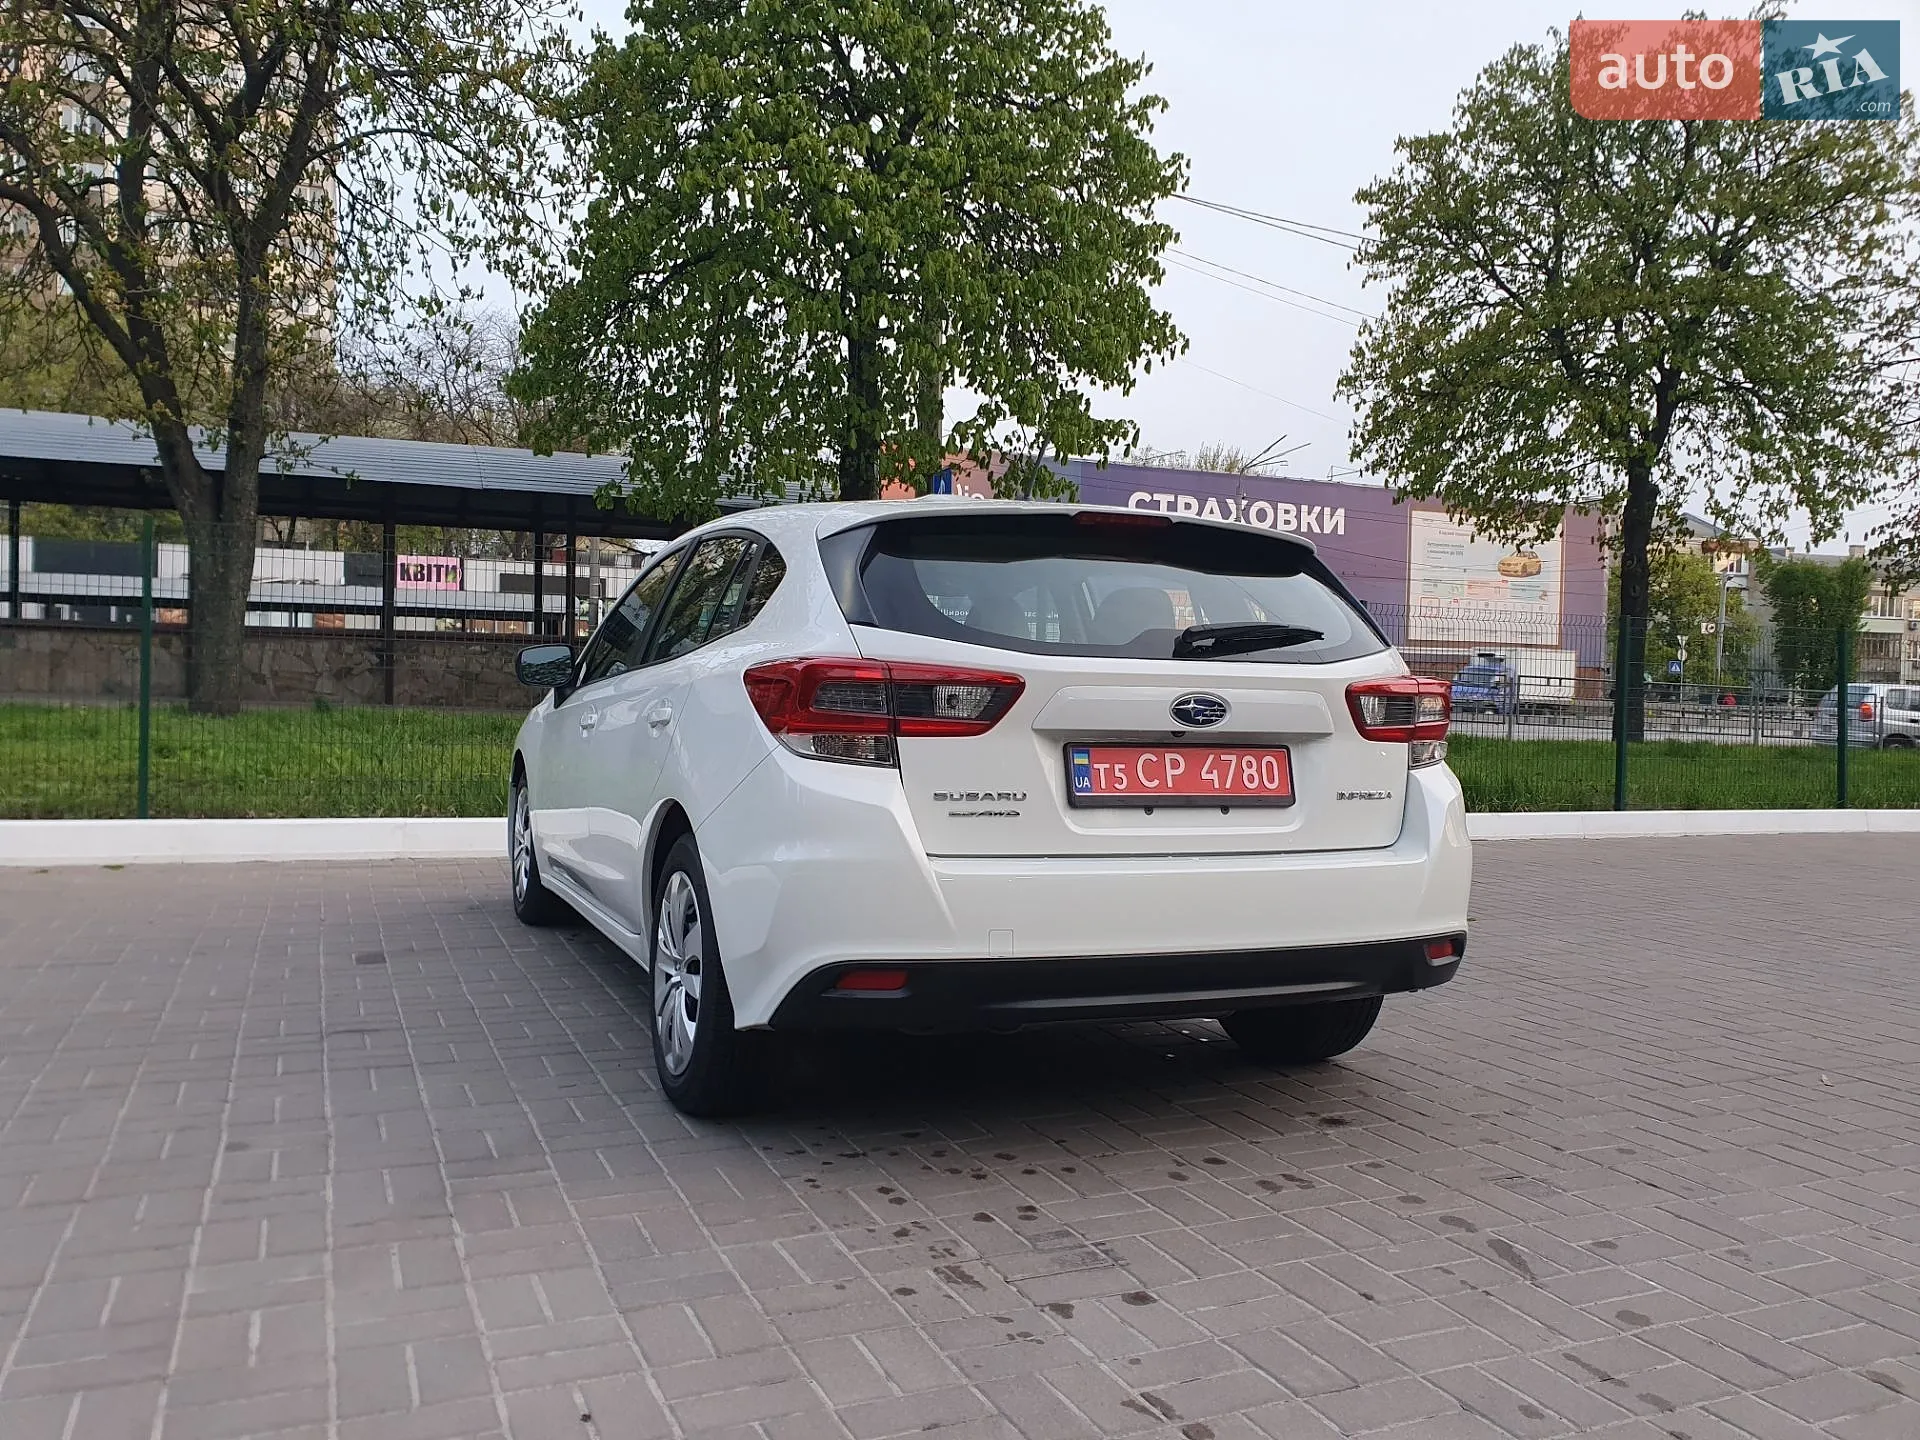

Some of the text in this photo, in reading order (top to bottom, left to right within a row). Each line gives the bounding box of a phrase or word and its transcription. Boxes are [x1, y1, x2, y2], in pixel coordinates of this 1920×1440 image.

[1128, 491, 1346, 535] СТРАХОВКИ
[400, 563, 457, 582] КВІТИ
[1094, 752, 1280, 790] T5 CP 4780
[1075, 776, 1091, 788] UA
[933, 792, 1027, 801] SUBARU
[1336, 791, 1393, 800] IMPREZA
